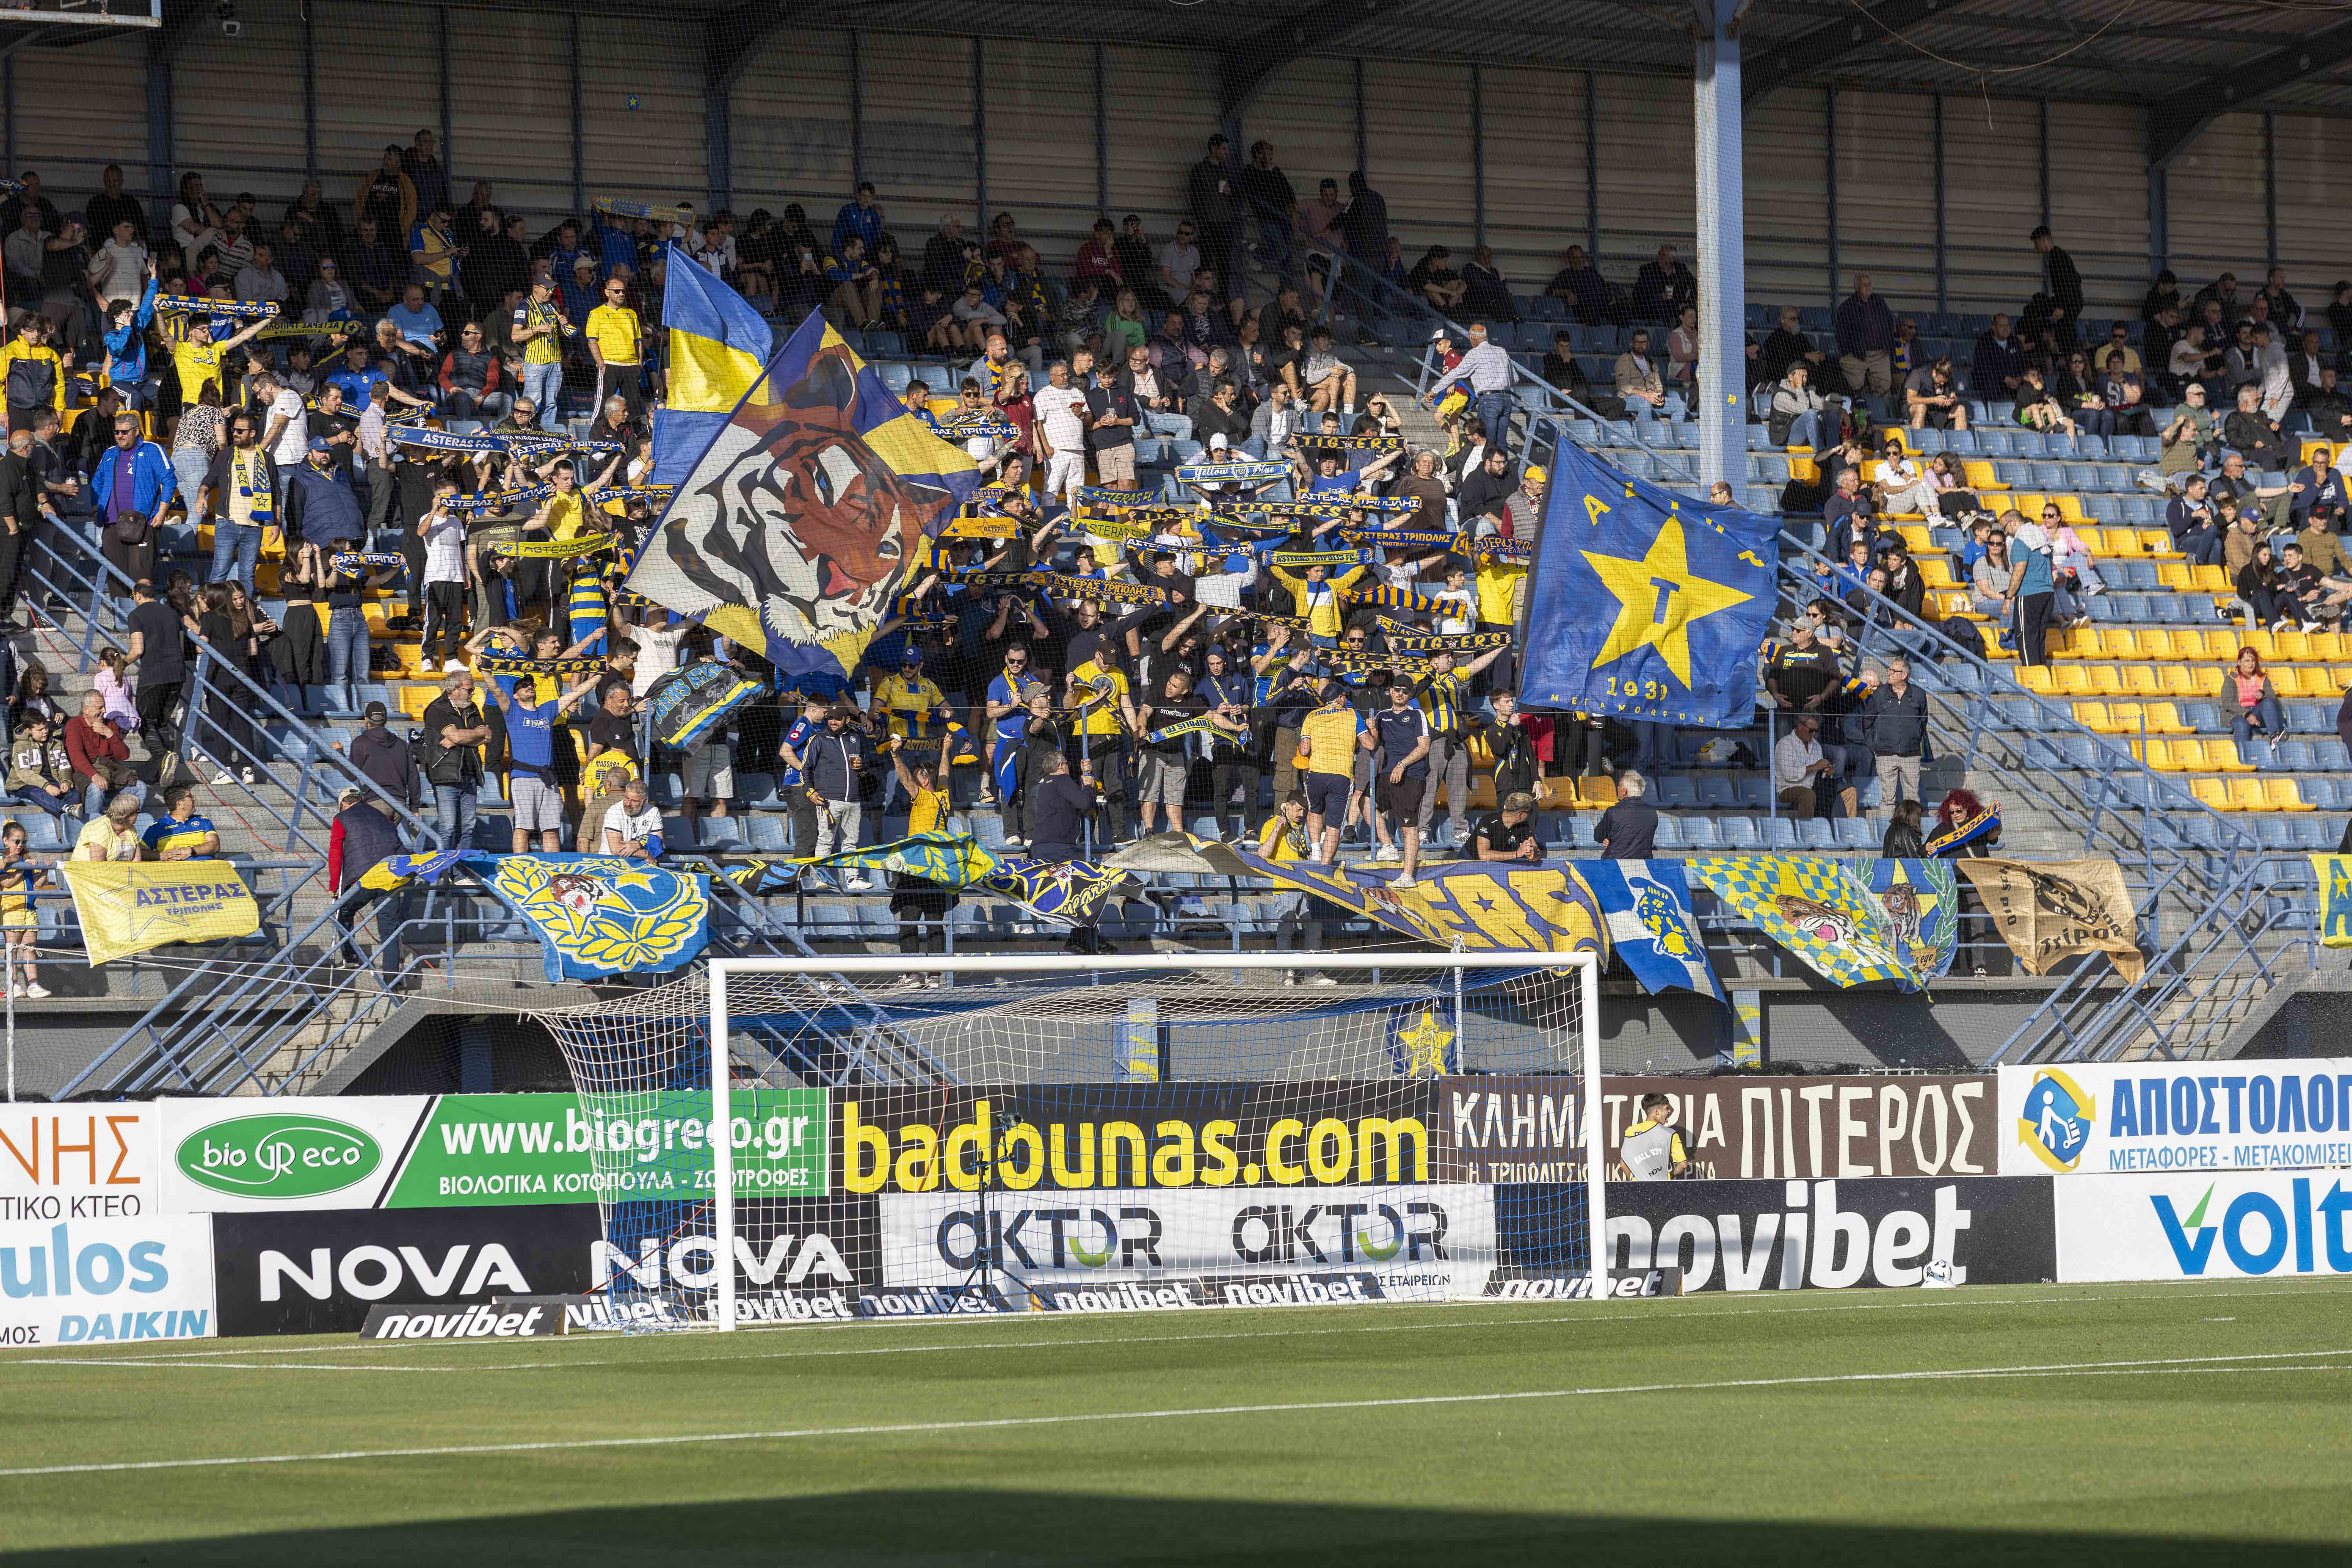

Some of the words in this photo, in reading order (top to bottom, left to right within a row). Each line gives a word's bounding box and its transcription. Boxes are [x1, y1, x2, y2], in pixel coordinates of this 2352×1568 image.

[159, 300, 209, 309] ΑΣΤΕΡΑΣ
[216, 304, 276, 313] ΤΡΙΠΟΛΗΣ
[421, 433, 473, 448] ASTERAS
[474, 439, 494, 448] F.C.
[960, 427, 1017, 435] ΤΡΙΠΟΛΗΣ
[517, 443, 564, 457] ΑΣΤΕΡΑΣ
[1193, 466, 1229, 481] Yellow
[1252, 464, 1275, 475] Blue
[441, 499, 494, 507] ΑΣΤΕΡΑΣ
[502, 485, 552, 504] ΤΡΙΠΟΛΗΣ
[1093, 490, 1142, 505] ASTERAS
[1301, 493, 1352, 503] ΑΣΤΕΡΑΣ
[1089, 524, 1129, 538] STERAS
[1403, 532, 1451, 543] ΤΡΙΠΟΛΗΣ
[366, 554, 399, 564] ΤΡΙΠΟ
[1054, 577, 1100, 590] ΑΣΤΕΡΑΣ
[1104, 583, 1151, 595] ΤΡΙΠΟΛΗΣ
[1342, 660, 1433, 673] TIGER
[136, 882, 246, 907] ΑΣΤΕΡΑΣ
[166, 902, 223, 916] ΤΡΙΠΟΛΗΣ
[1740, 1081, 1984, 1178] ΠΙΤΕΡΟΣ
[203, 1139, 247, 1167] bio
[303, 1145, 362, 1166] eco
[844, 1100, 1427, 1193] badounas.com
[1633, 1151, 1651, 1165] BALL
[2109, 1145, 2218, 1170] ΜΕΤΑΦΟΡΕΣ
[440, 1174, 546, 1195] ΒΙΟΛΟΓΙΚΑ
[554, 1171, 675, 1192] ΚΟΤΟΠΟΥΛΑ
[72, 1195, 140, 1218] ΚΤΕΟ
[1606, 1180, 1971, 1292] novibet
[260, 1242, 532, 1301] NOVA
[590, 1232, 854, 1290] NOVA
[1223, 1275, 1367, 1305] novibet
[1389, 1274, 1450, 1286] ΕΤΑΙΡΕΙΩΝ
[1500, 1270, 1662, 1299] noviet
[860, 1287, 998, 1314] novibet
[1054, 1282, 1197, 1311] novibet
[375, 1305, 544, 1339] novibet
[566, 1294, 672, 1327] vibet
[58, 1310, 208, 1343] DAIKIN
